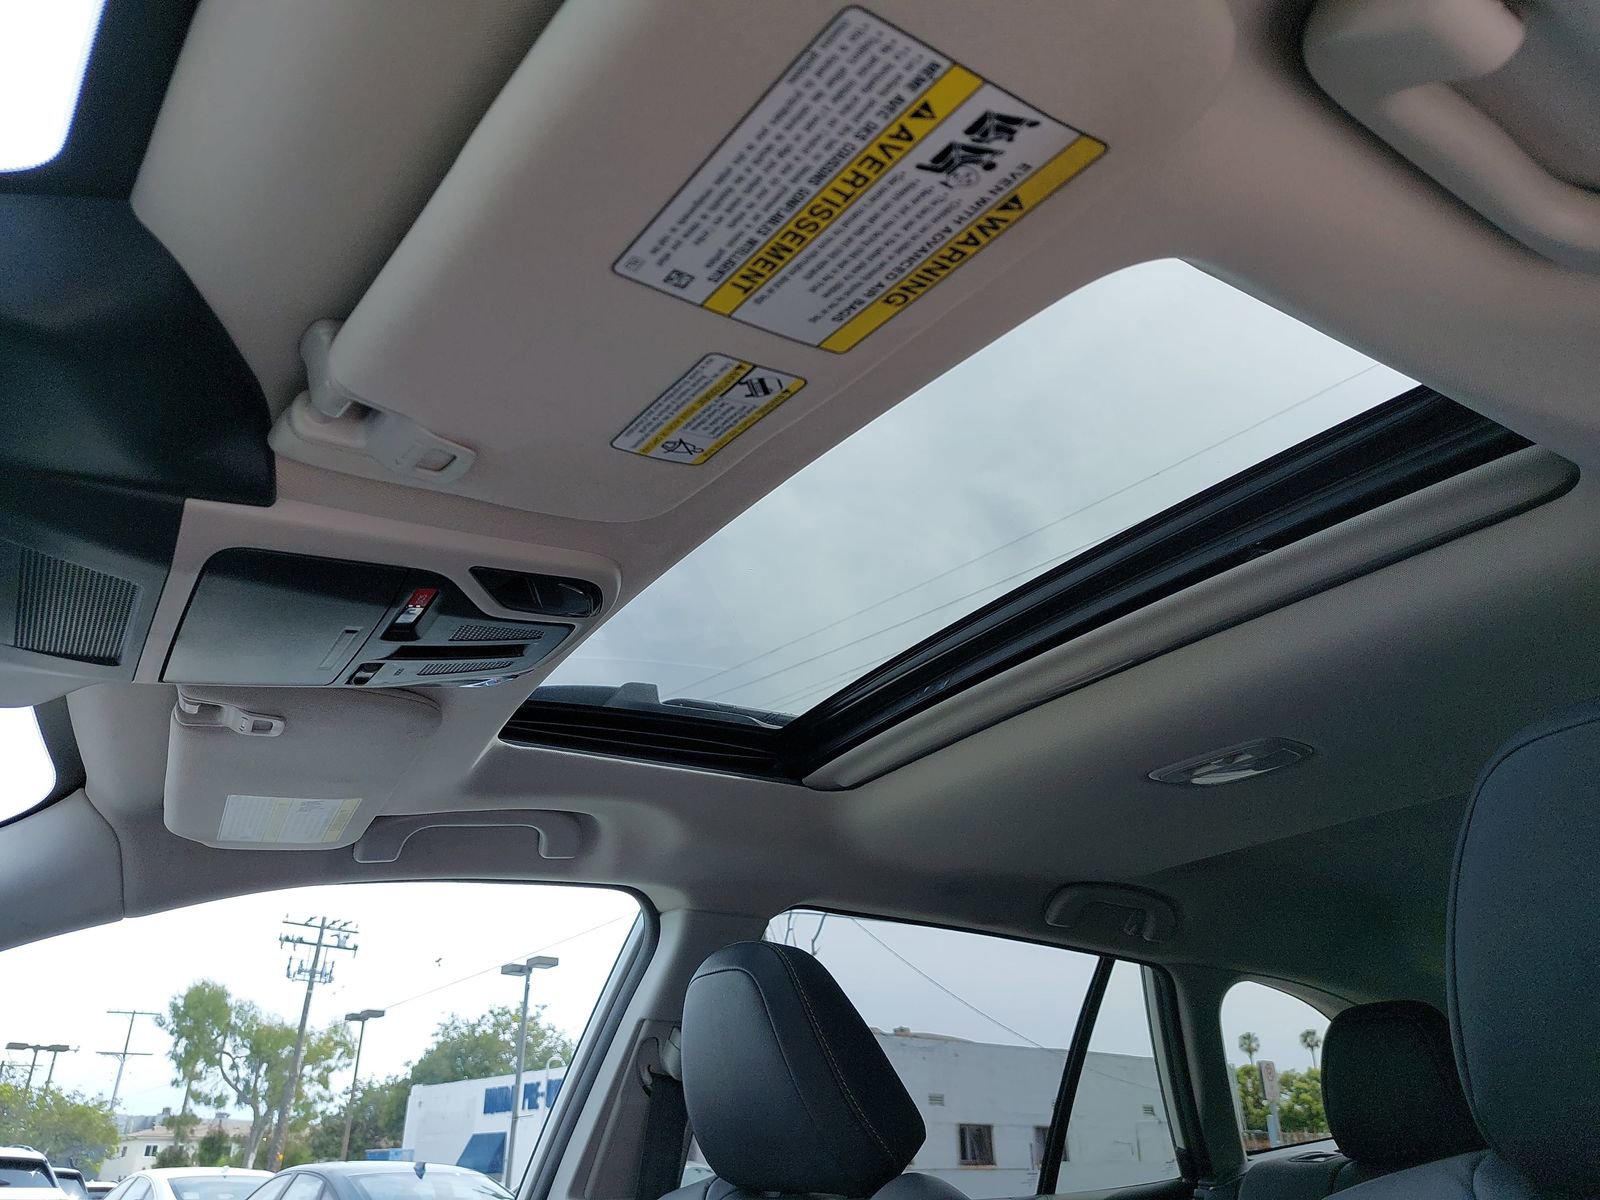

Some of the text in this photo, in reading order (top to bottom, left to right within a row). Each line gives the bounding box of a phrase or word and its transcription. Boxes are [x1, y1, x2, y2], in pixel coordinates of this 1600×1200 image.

[986, 161, 1032, 196] EVEN
[726, 122, 920, 295] AVERTISSEMENT
[950, 194, 992, 225] WITH
[881, 213, 1007, 308] WARNING
[882, 224, 955, 281] ADVANCED
